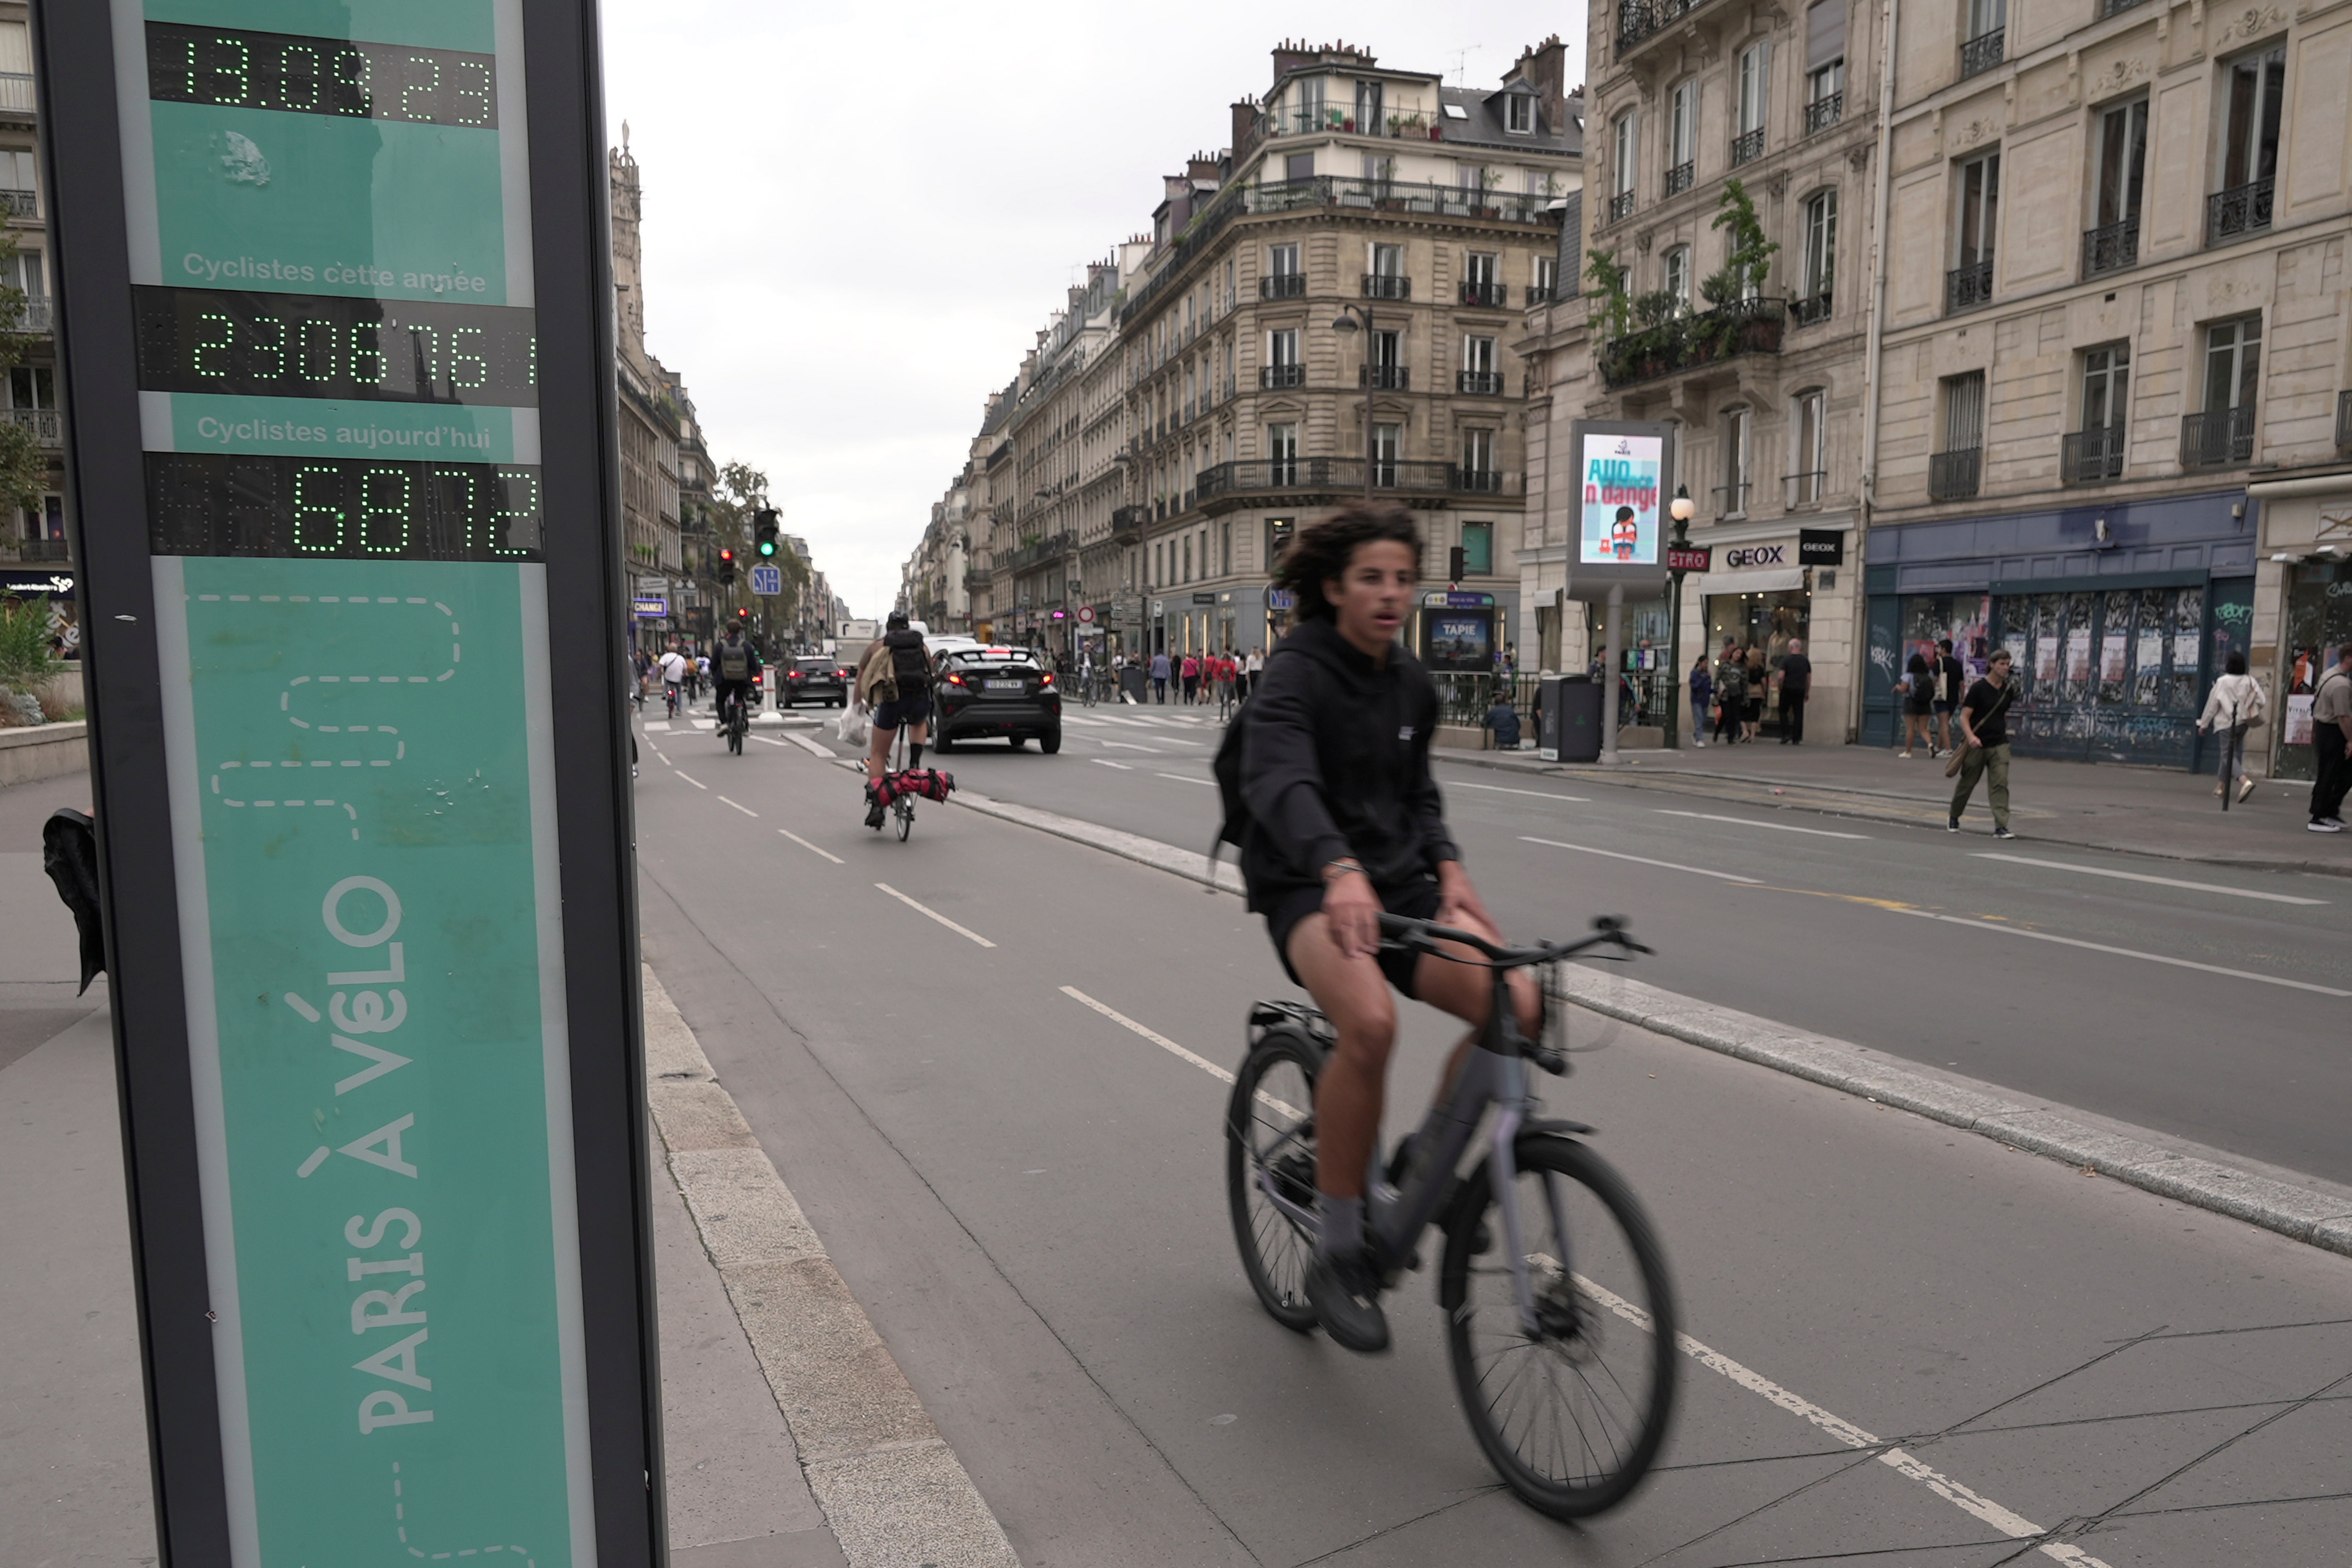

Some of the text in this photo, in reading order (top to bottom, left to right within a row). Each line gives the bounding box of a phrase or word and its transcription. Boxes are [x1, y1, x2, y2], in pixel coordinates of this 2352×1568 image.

[188, 38, 490, 124] 13.09.23
[182, 252, 486, 293] Cyclistes cette année
[197, 416, 490, 449] Cyclistes aujourd'hui
[293, 466, 537, 555] 6872
[1602, 485, 1657, 512] dange
[1668, 552, 1705, 568] ETRO
[1727, 545, 1786, 567] GEOX
[1802, 543, 1836, 552] GEOX
[1443, 624, 1476, 635] TAPIE
[296, 1111, 418, 1180] À
[343, 1206, 435, 1435] PARIS
